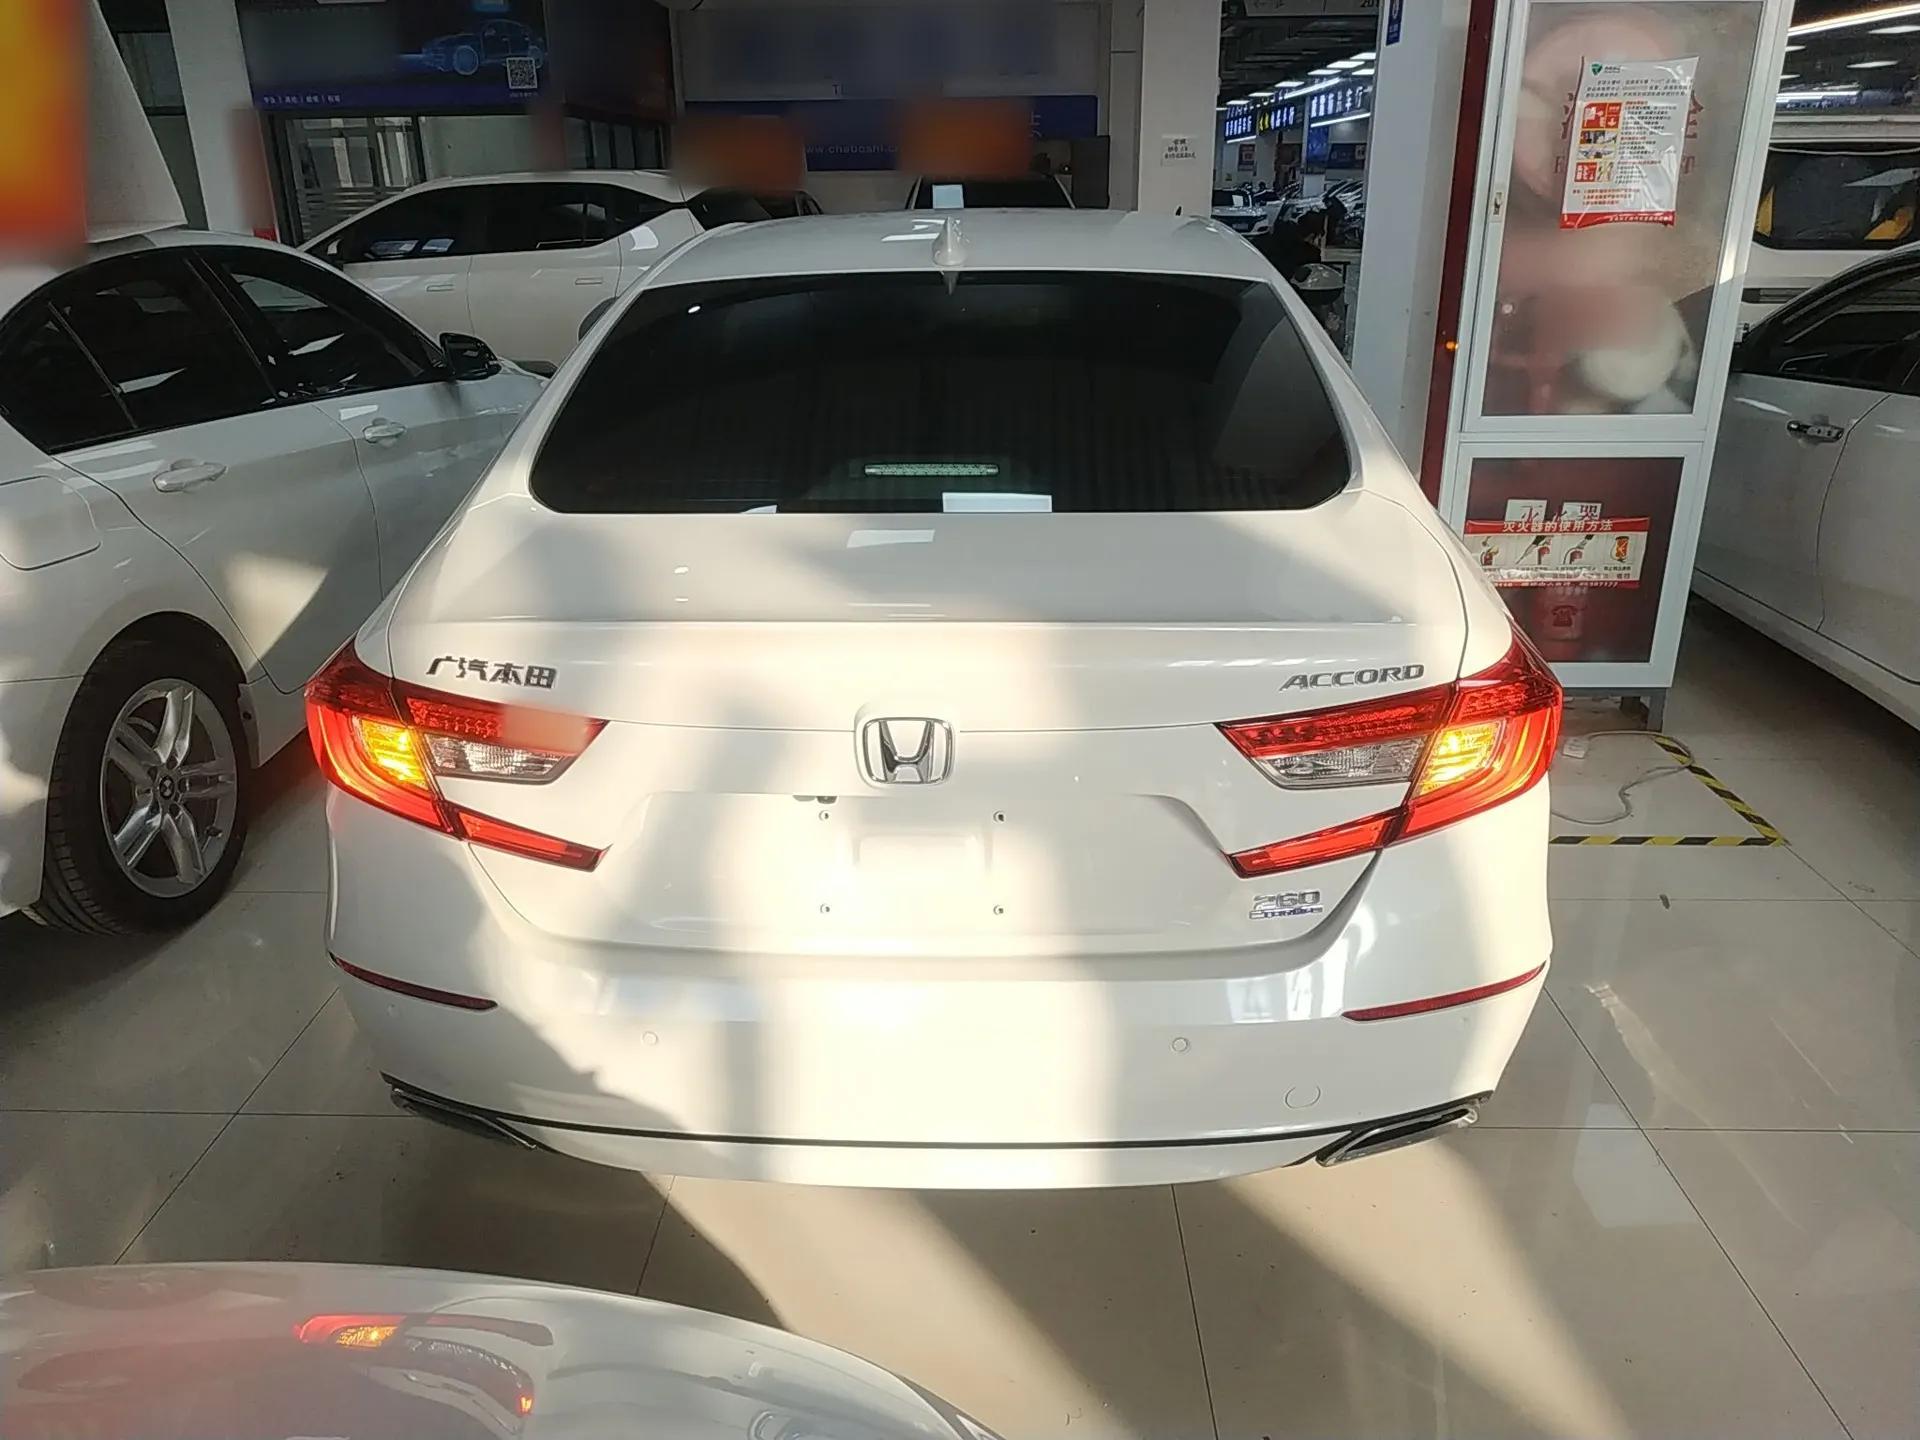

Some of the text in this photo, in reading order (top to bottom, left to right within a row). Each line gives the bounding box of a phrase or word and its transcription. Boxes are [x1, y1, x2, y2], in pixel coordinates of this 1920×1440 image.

[1502, 519, 1613, 533] 灭火器的使用方法
[426, 655, 557, 689] 广汽本田
[1278, 664, 1425, 692] ACCORD
[1253, 890, 1321, 911] 260
